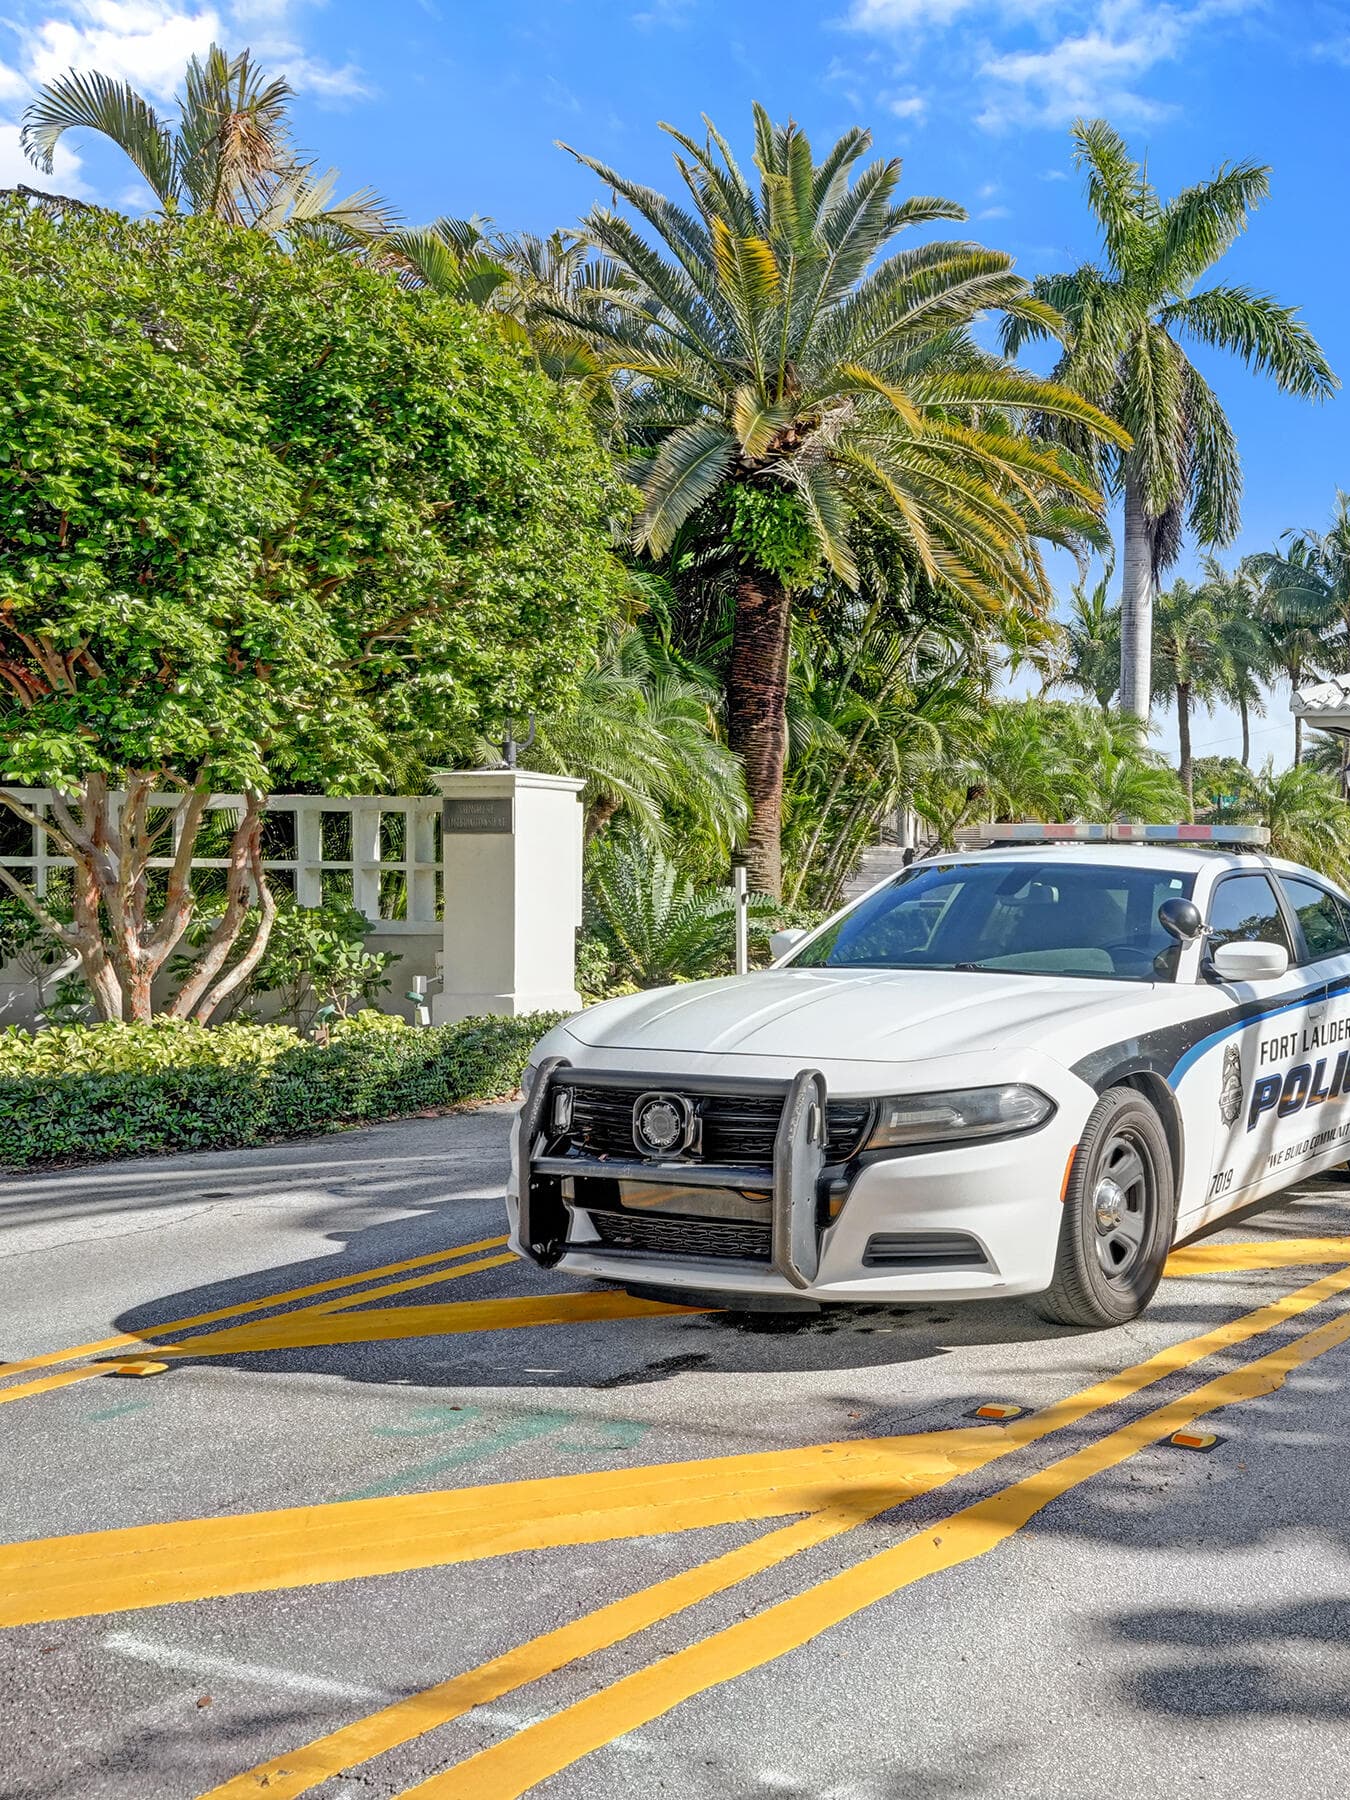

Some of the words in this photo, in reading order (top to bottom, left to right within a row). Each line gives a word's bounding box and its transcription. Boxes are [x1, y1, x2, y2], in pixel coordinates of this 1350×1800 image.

[1260, 1033, 1298, 1065] FORT
[1284, 1140, 1310, 1161] BUILD
[1209, 1168, 1234, 1197] 7019
